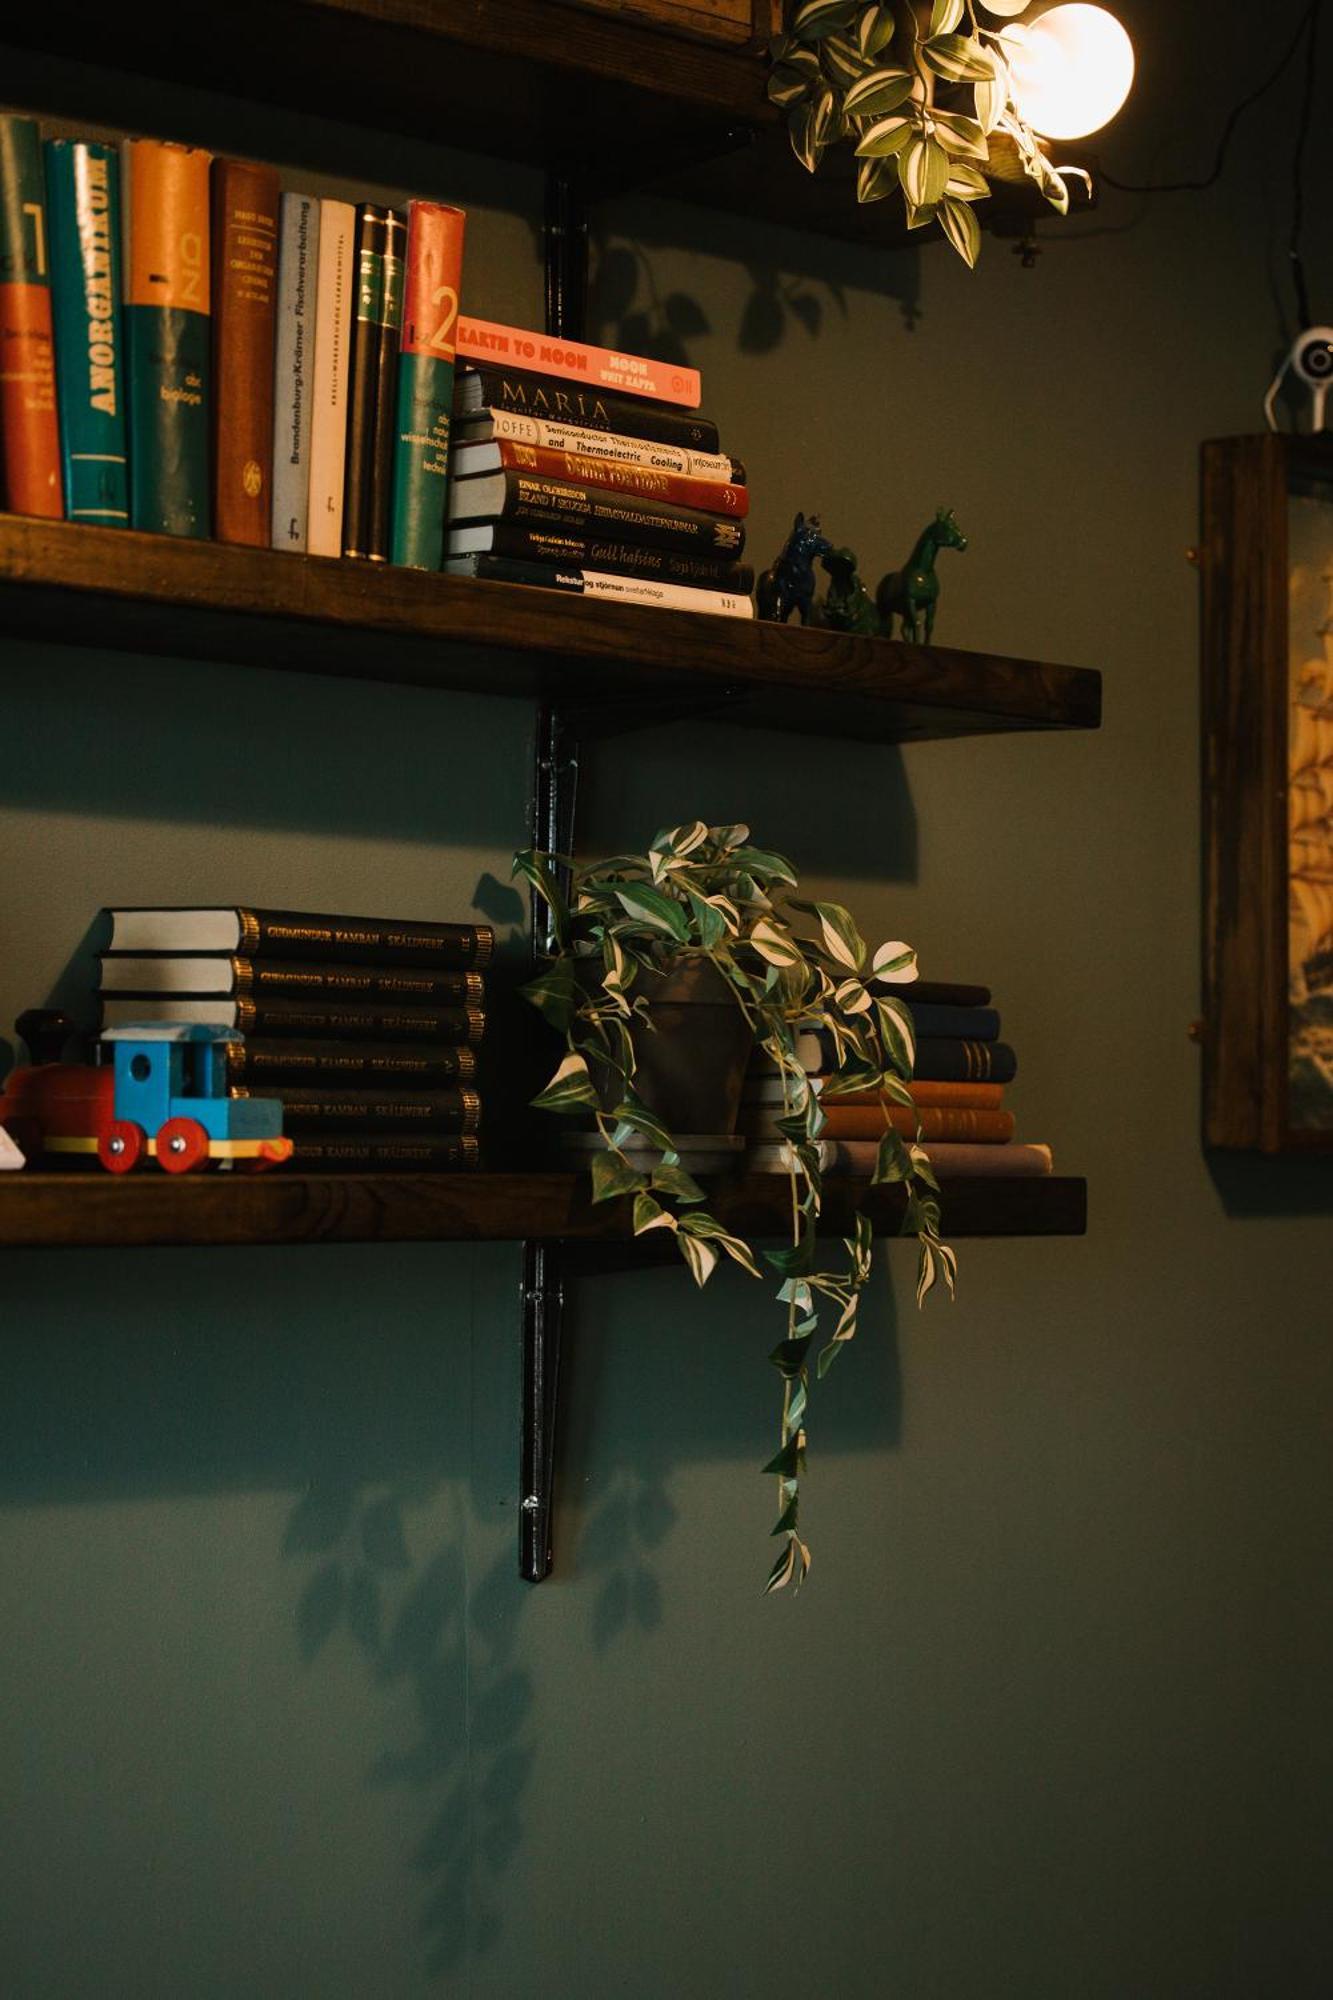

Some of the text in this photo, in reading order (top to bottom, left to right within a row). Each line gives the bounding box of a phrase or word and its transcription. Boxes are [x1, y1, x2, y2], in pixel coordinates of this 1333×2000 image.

[296, 201, 310, 316] Fischverarbeitung
[80, 158, 116, 417] ANORGANIKUM
[432, 287, 458, 352] 2
[458, 327, 588, 371] EARTH TO MOON
[610, 356, 648, 374] MOON
[502, 381, 609, 421] MARÍA
[496, 420, 533, 437] IOFFE
[548, 438, 683, 472] and Thermoelectric Cooling
